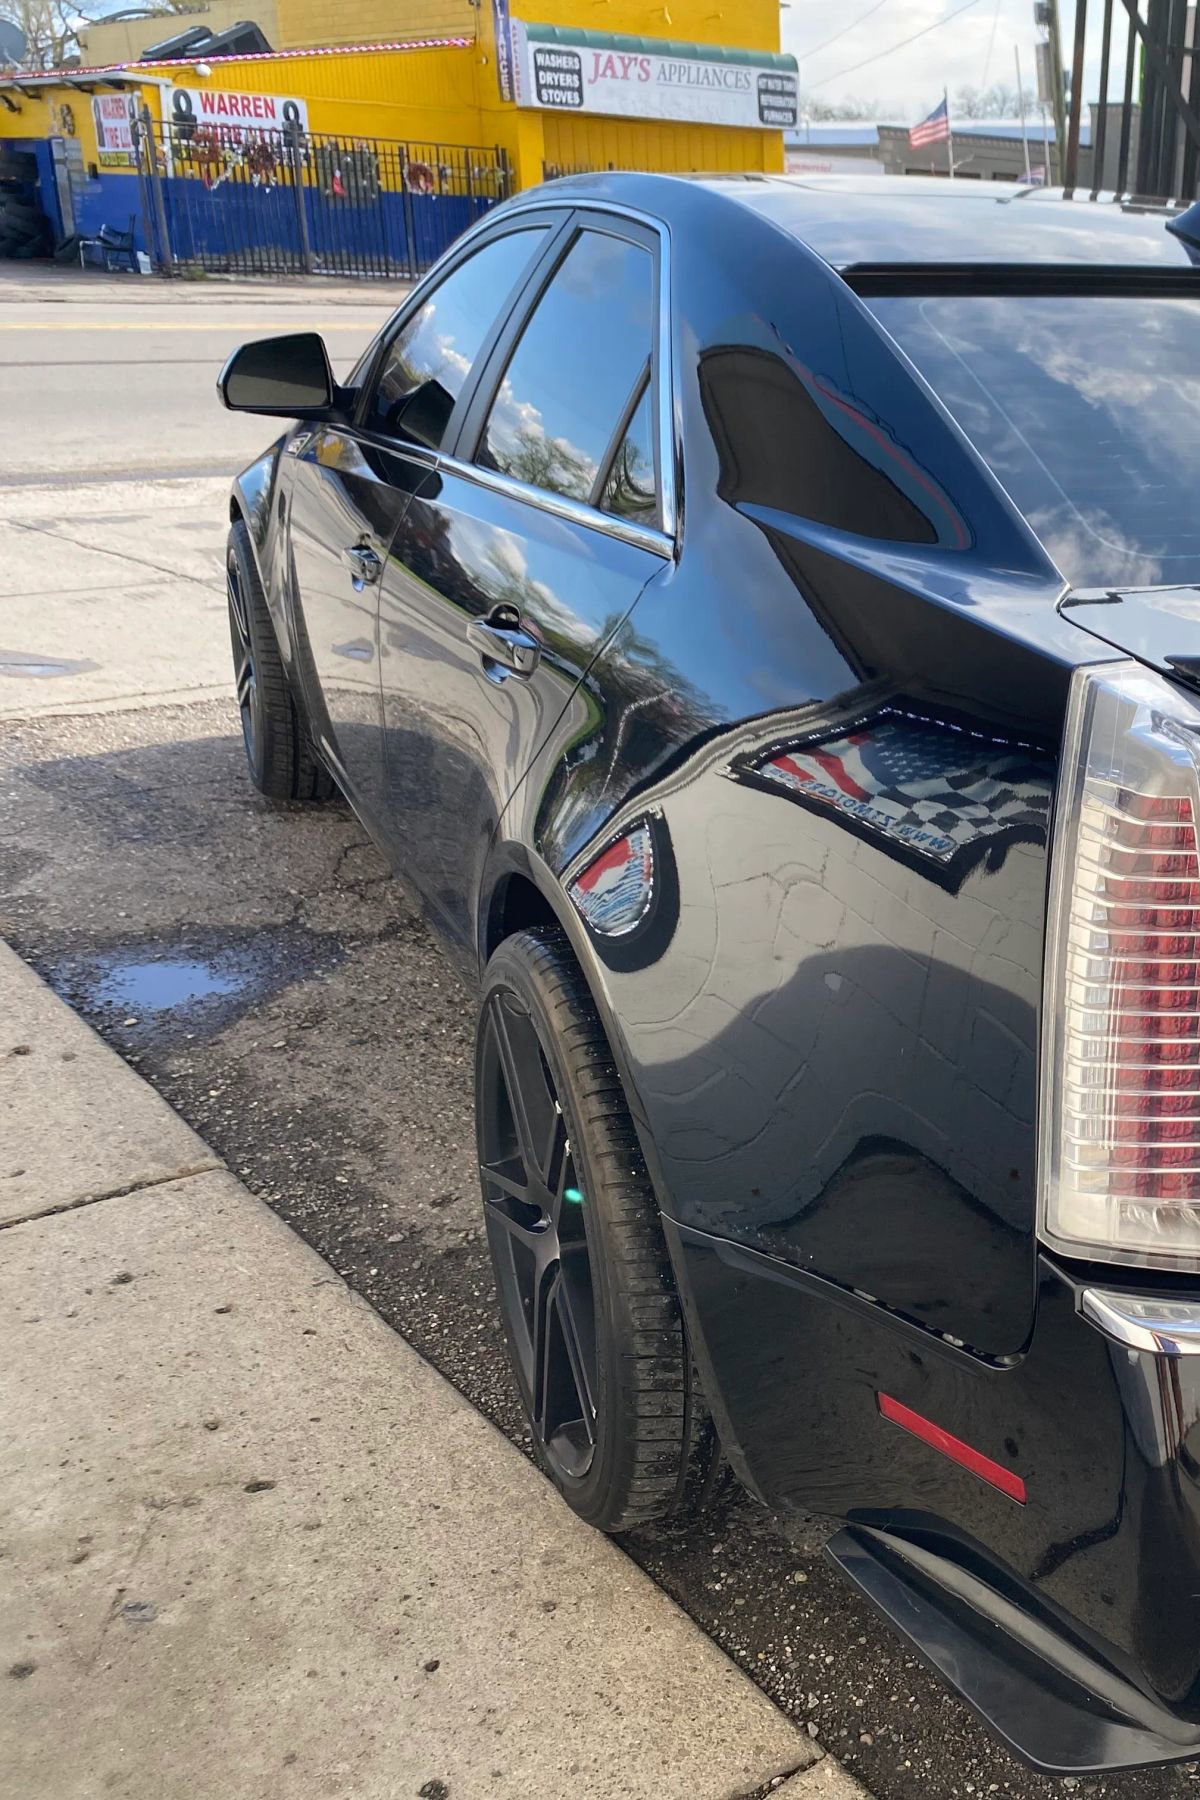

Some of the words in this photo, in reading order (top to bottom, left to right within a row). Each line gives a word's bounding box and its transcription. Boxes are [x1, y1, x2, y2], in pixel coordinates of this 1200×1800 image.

[536, 53, 580, 70] WASHERS
[538, 71, 580, 88] DRYERS
[588, 52, 651, 85] JAY'S
[656, 62, 752, 90] APPLIANCES
[200, 91, 276, 119] WARREN
[541, 89, 580, 105] STOVES
